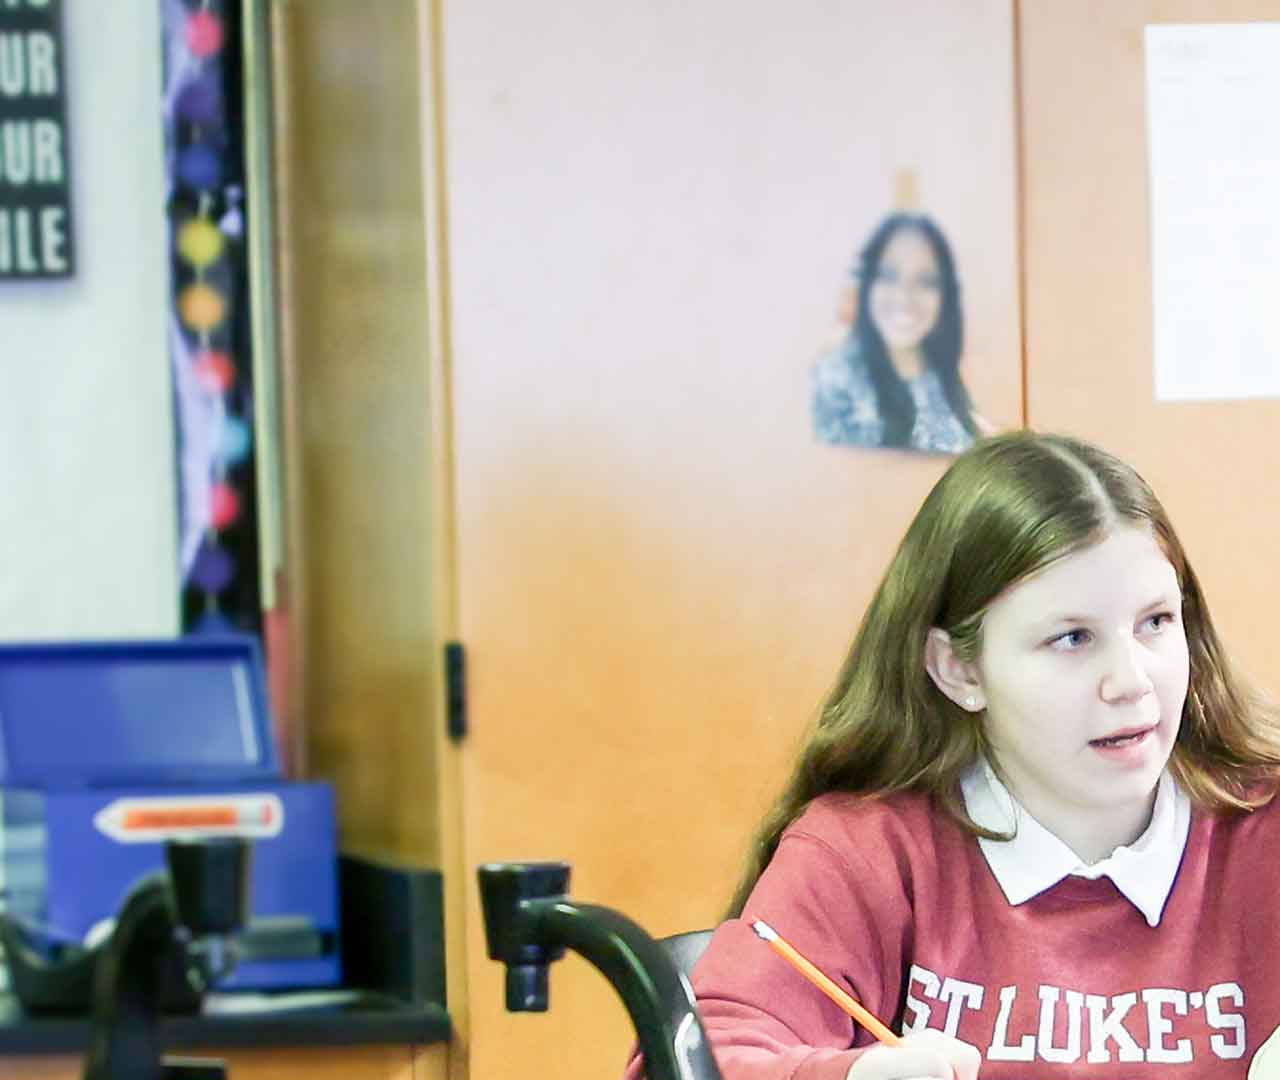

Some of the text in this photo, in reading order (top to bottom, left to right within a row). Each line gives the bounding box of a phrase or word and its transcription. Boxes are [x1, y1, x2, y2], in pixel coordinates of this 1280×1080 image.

[0, 119, 63, 184] UR
[901, 964, 1246, 1064] ST LUKE'S
